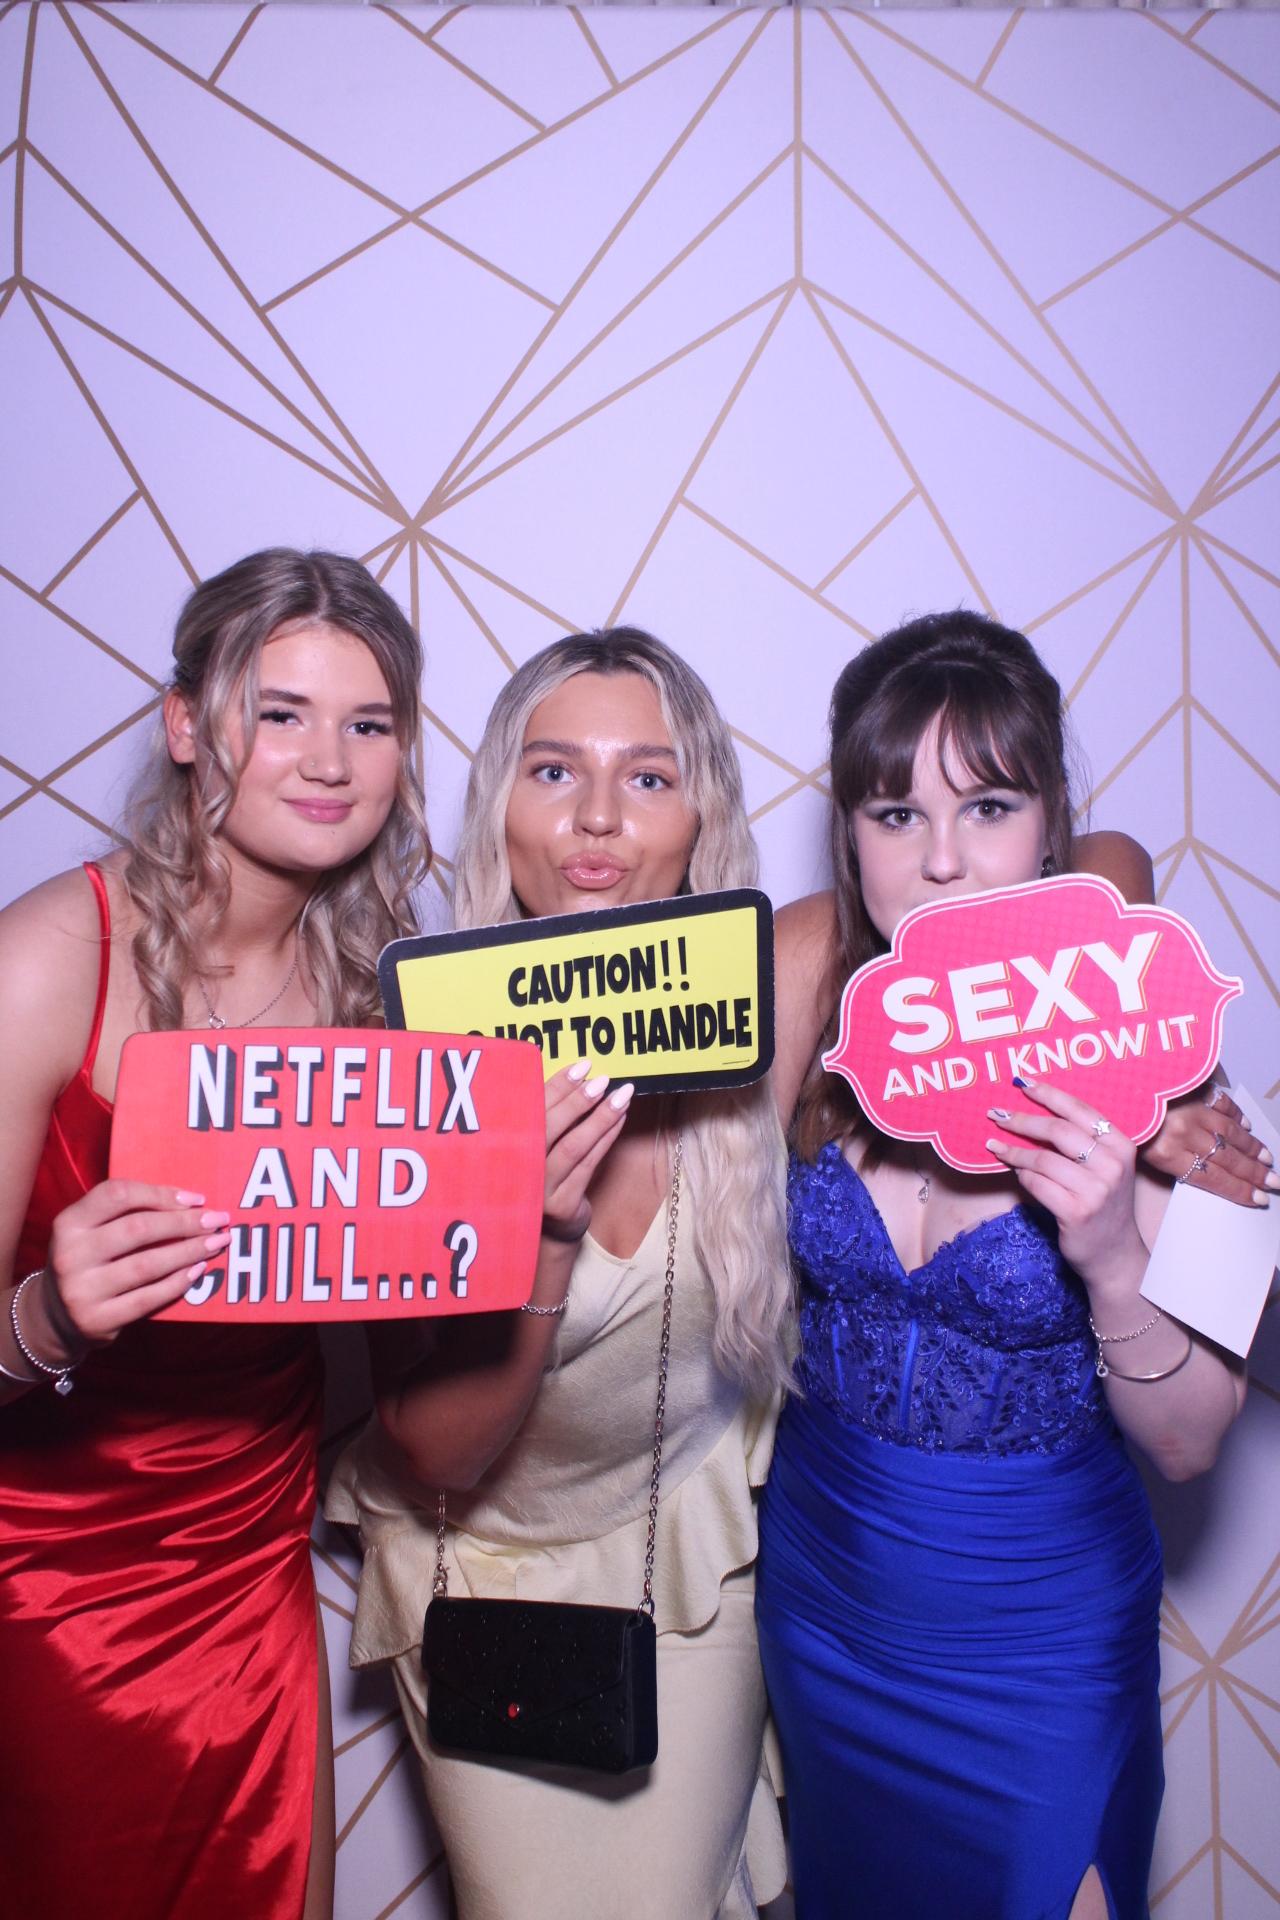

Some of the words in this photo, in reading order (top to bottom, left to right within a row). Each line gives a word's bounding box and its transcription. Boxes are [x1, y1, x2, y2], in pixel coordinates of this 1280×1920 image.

[508, 936, 690, 1007] CAUTION!!
[881, 930, 1163, 1054] SEXY
[570, 1015, 615, 1057] TO
[623, 997, 752, 1055] HANDLE
[883, 1056, 976, 1101] AND
[985, 1051, 1001, 1083] I
[1009, 1023, 1148, 1079] KNOW
[1157, 1013, 1198, 1052] IT
[187, 1043, 481, 1134] NETFLIX
[239, 1147, 429, 1209] AND
